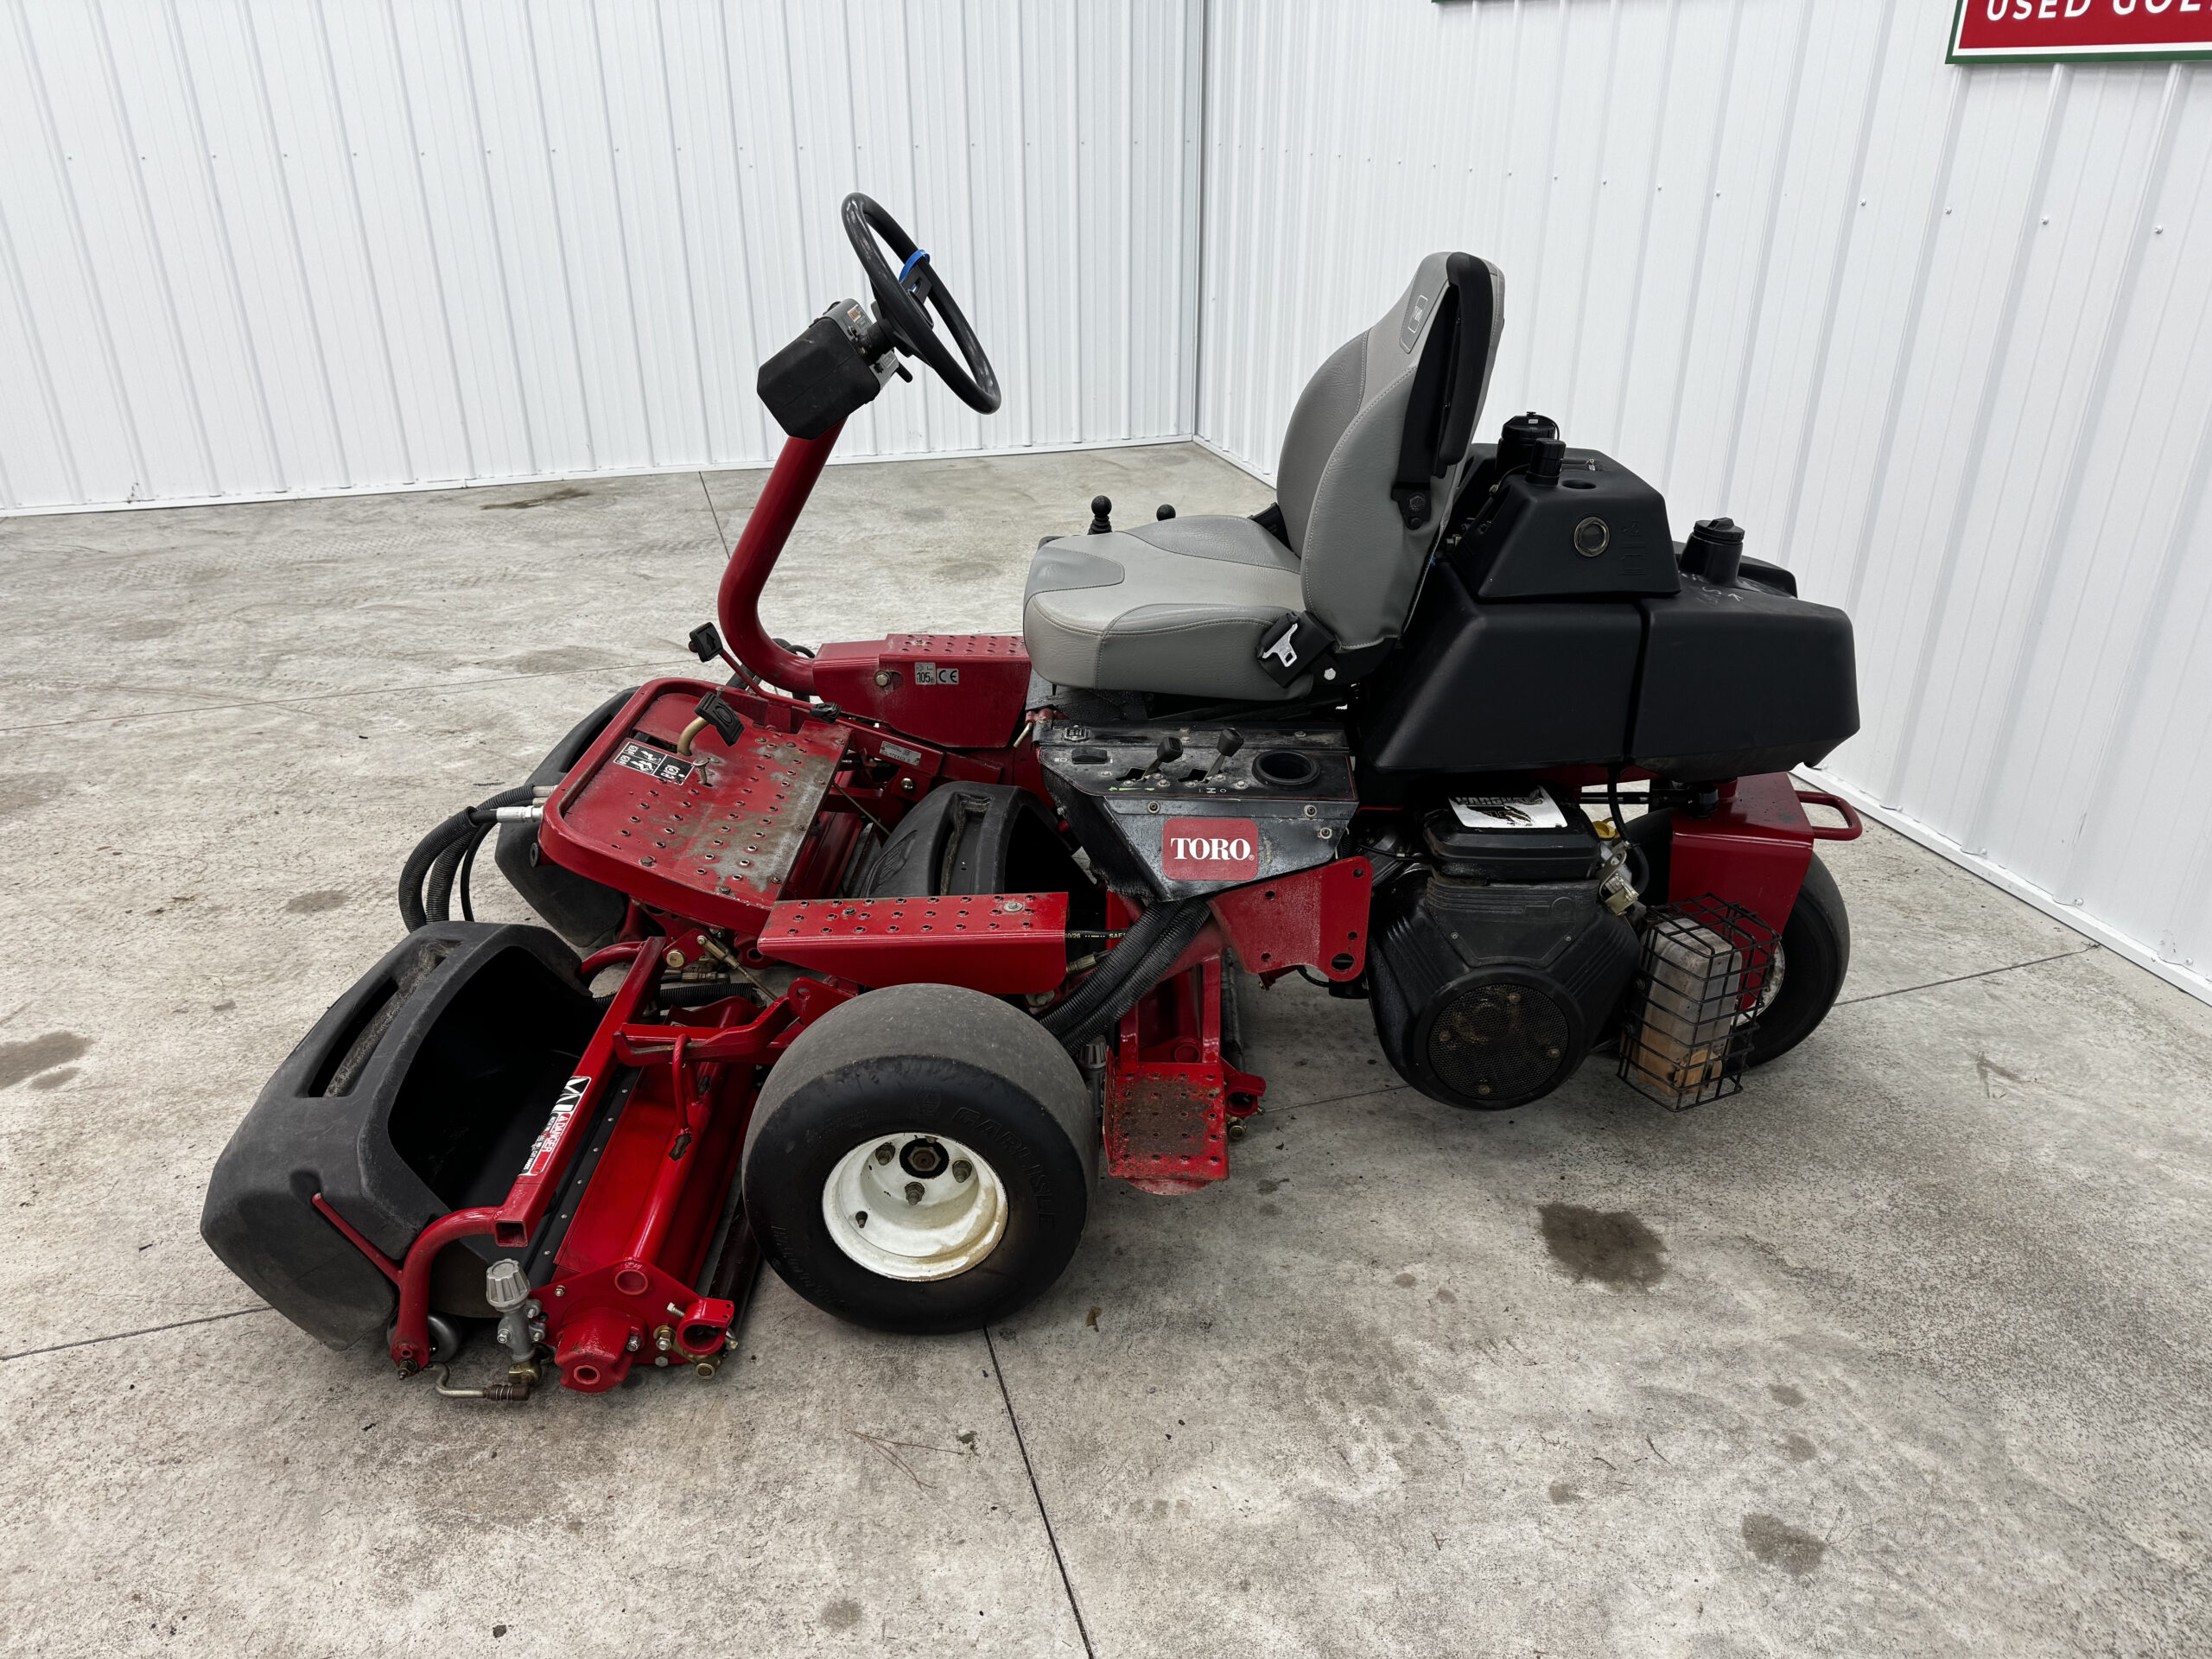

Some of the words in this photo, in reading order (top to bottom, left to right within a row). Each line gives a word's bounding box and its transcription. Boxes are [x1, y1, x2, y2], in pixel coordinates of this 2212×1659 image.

[1986, 0, 2092, 21] USED
[917, 671, 931, 683] 105
[938, 670, 957, 683] CE
[541, 1122, 566, 1153] DANGER
